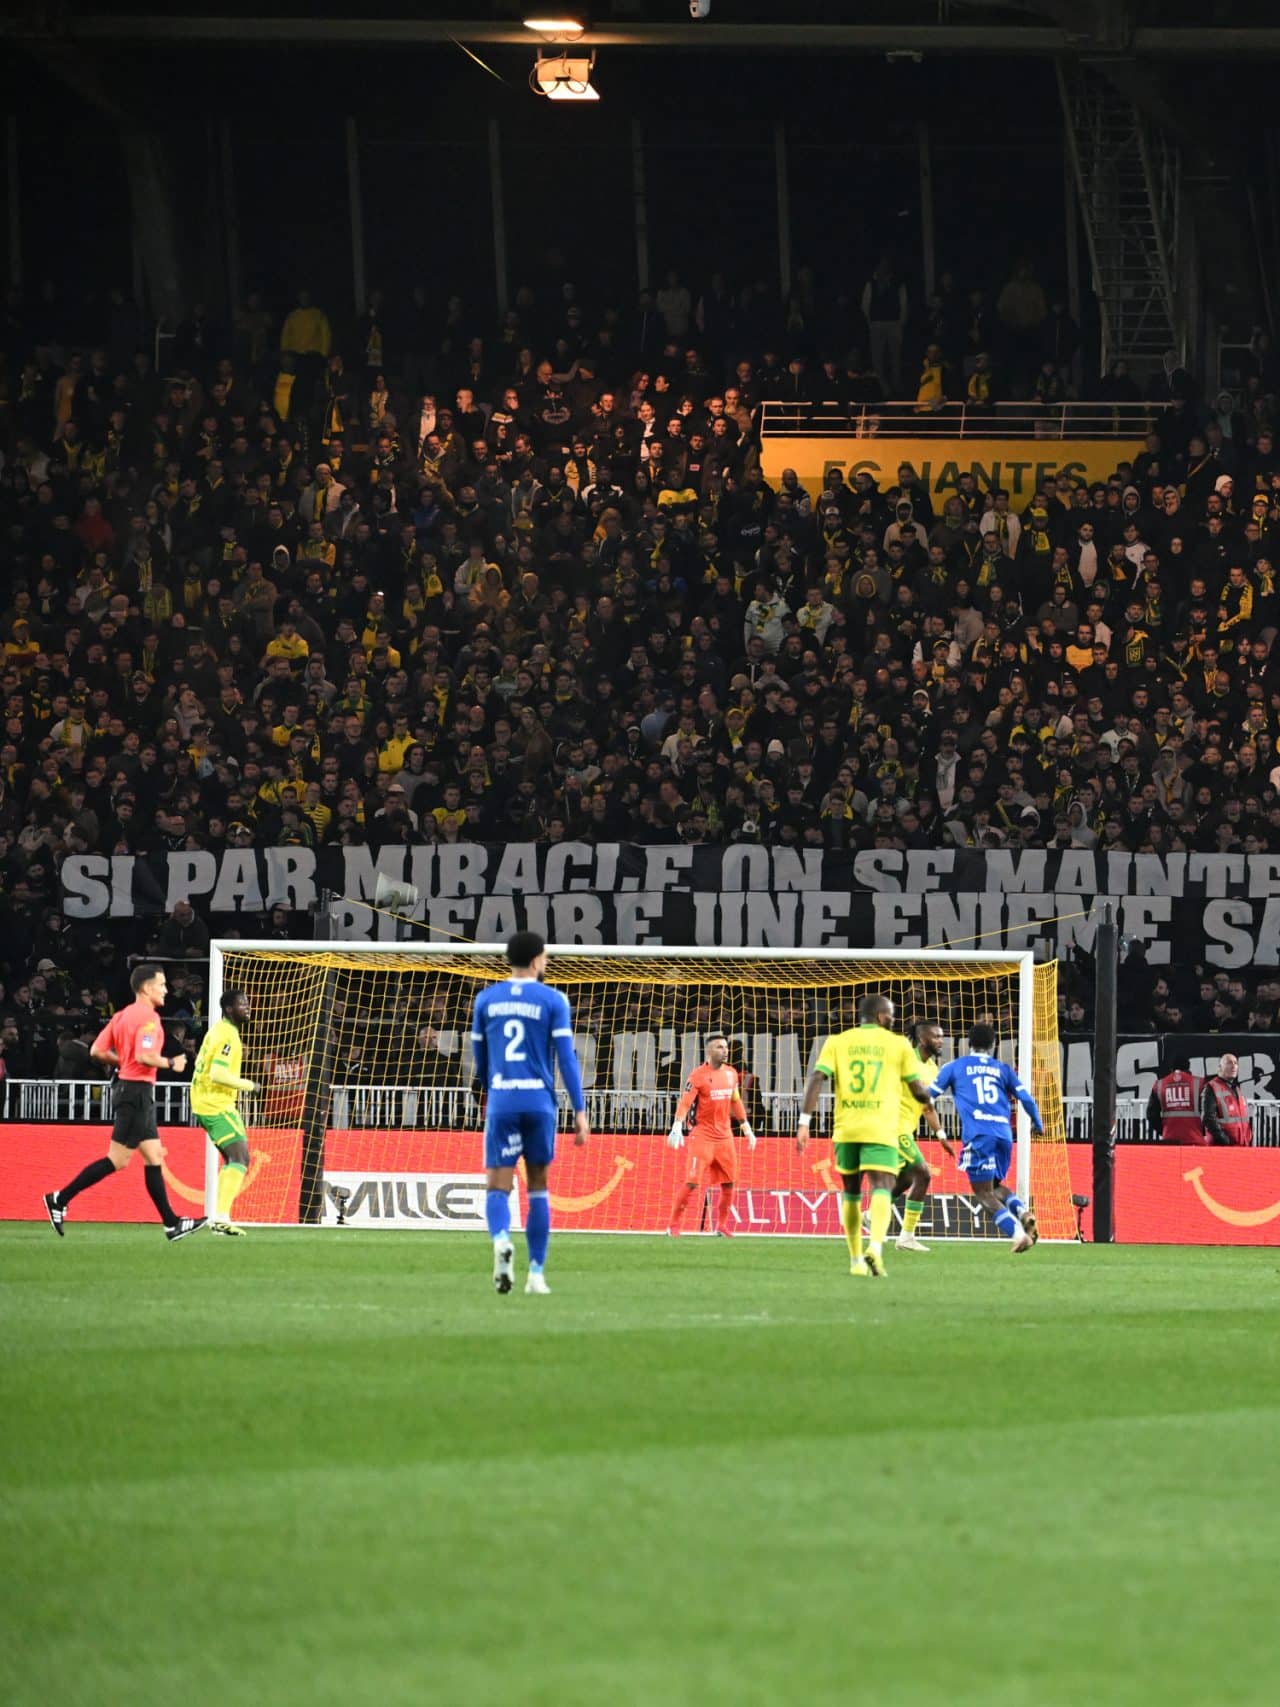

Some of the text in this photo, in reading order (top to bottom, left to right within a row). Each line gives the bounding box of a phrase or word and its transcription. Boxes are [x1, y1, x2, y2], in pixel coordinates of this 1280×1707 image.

[61, 854, 135, 919] SI
[165, 846, 320, 912] PAR
[343, 841, 694, 900] MIRACLE
[721, 844, 823, 892] ON
[853, 849, 955, 893] SE
[694, 891, 850, 948] UNE
[873, 891, 1171, 964] ENIEME
[503, 1019, 526, 1062] 2
[849, 1060, 883, 1094] 37
[972, 1076, 999, 1104] 15
[321, 1181, 513, 1220] MILLE
